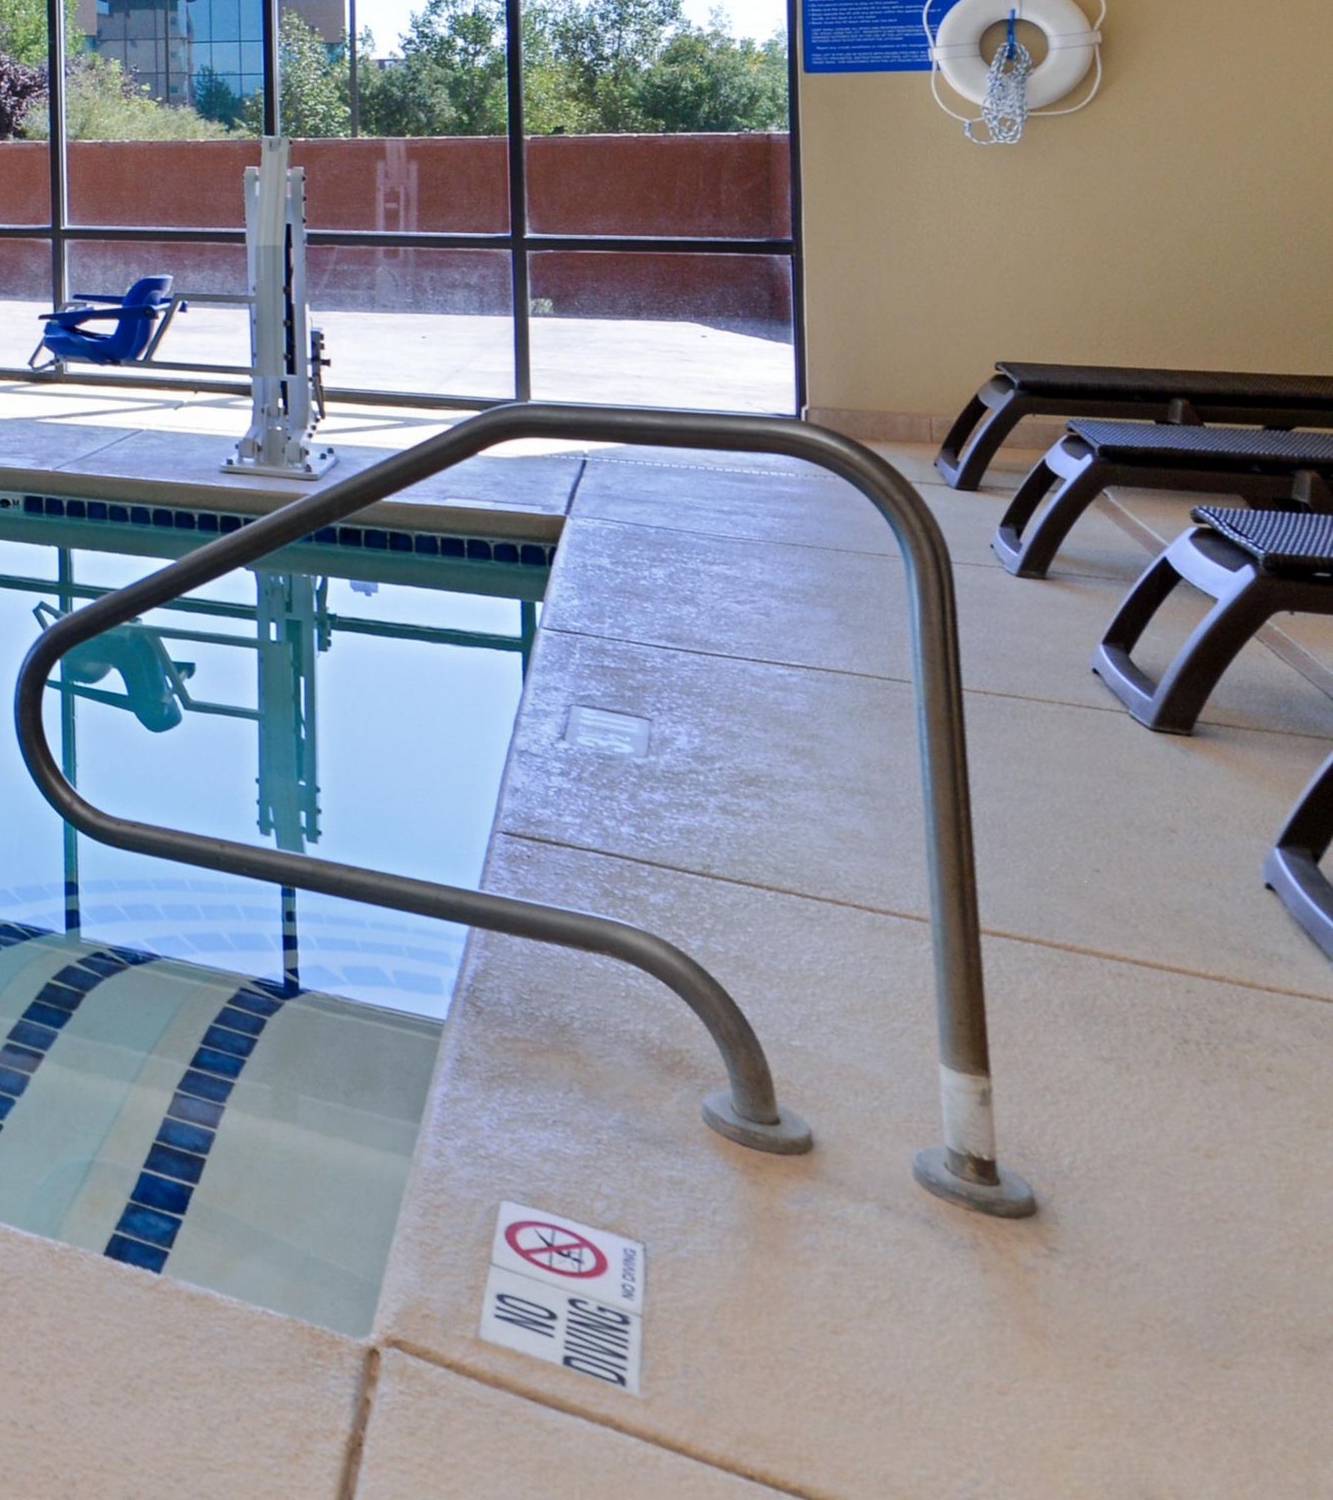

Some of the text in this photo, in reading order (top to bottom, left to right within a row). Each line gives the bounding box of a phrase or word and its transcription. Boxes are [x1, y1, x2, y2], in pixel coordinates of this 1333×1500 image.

[621, 1247, 638, 1302] NO DIVING
[493, 1293, 558, 1339] NO
[562, 1297, 631, 1387] DIVING
